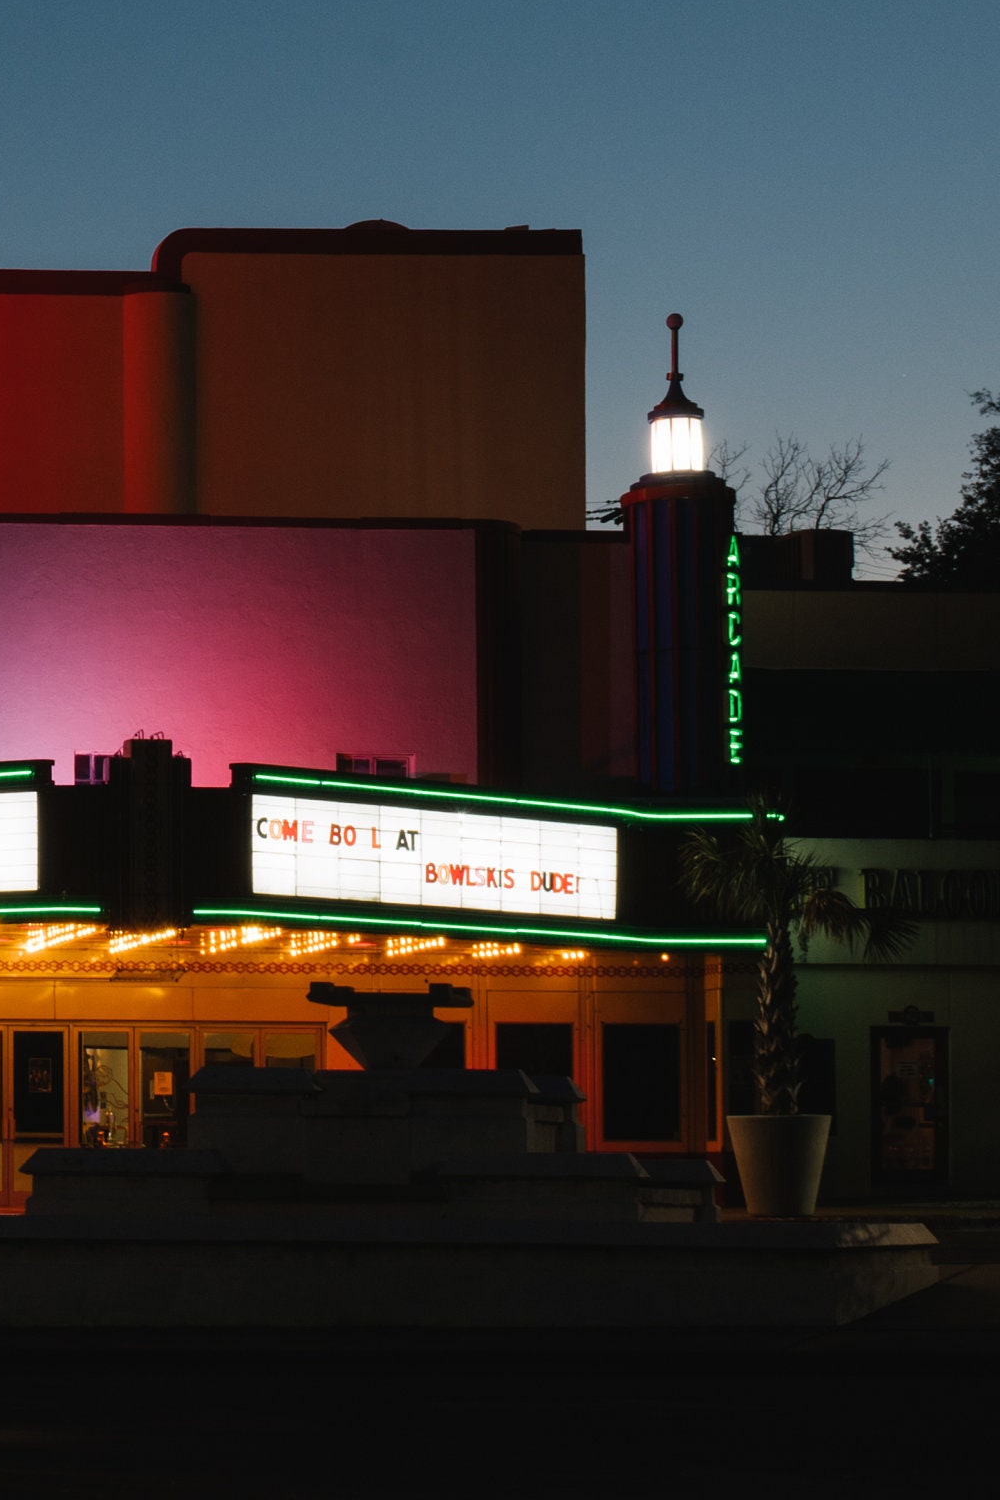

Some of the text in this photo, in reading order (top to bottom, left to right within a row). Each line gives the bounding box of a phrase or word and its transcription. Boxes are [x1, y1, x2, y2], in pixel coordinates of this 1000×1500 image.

[727, 534, 744, 765] ARCADE
[256, 817, 315, 844] COME
[395, 829, 419, 852] AT
[425, 862, 581, 895] BOWLSKIS DUDE!
[862, 868, 1000, 920] BALCO
